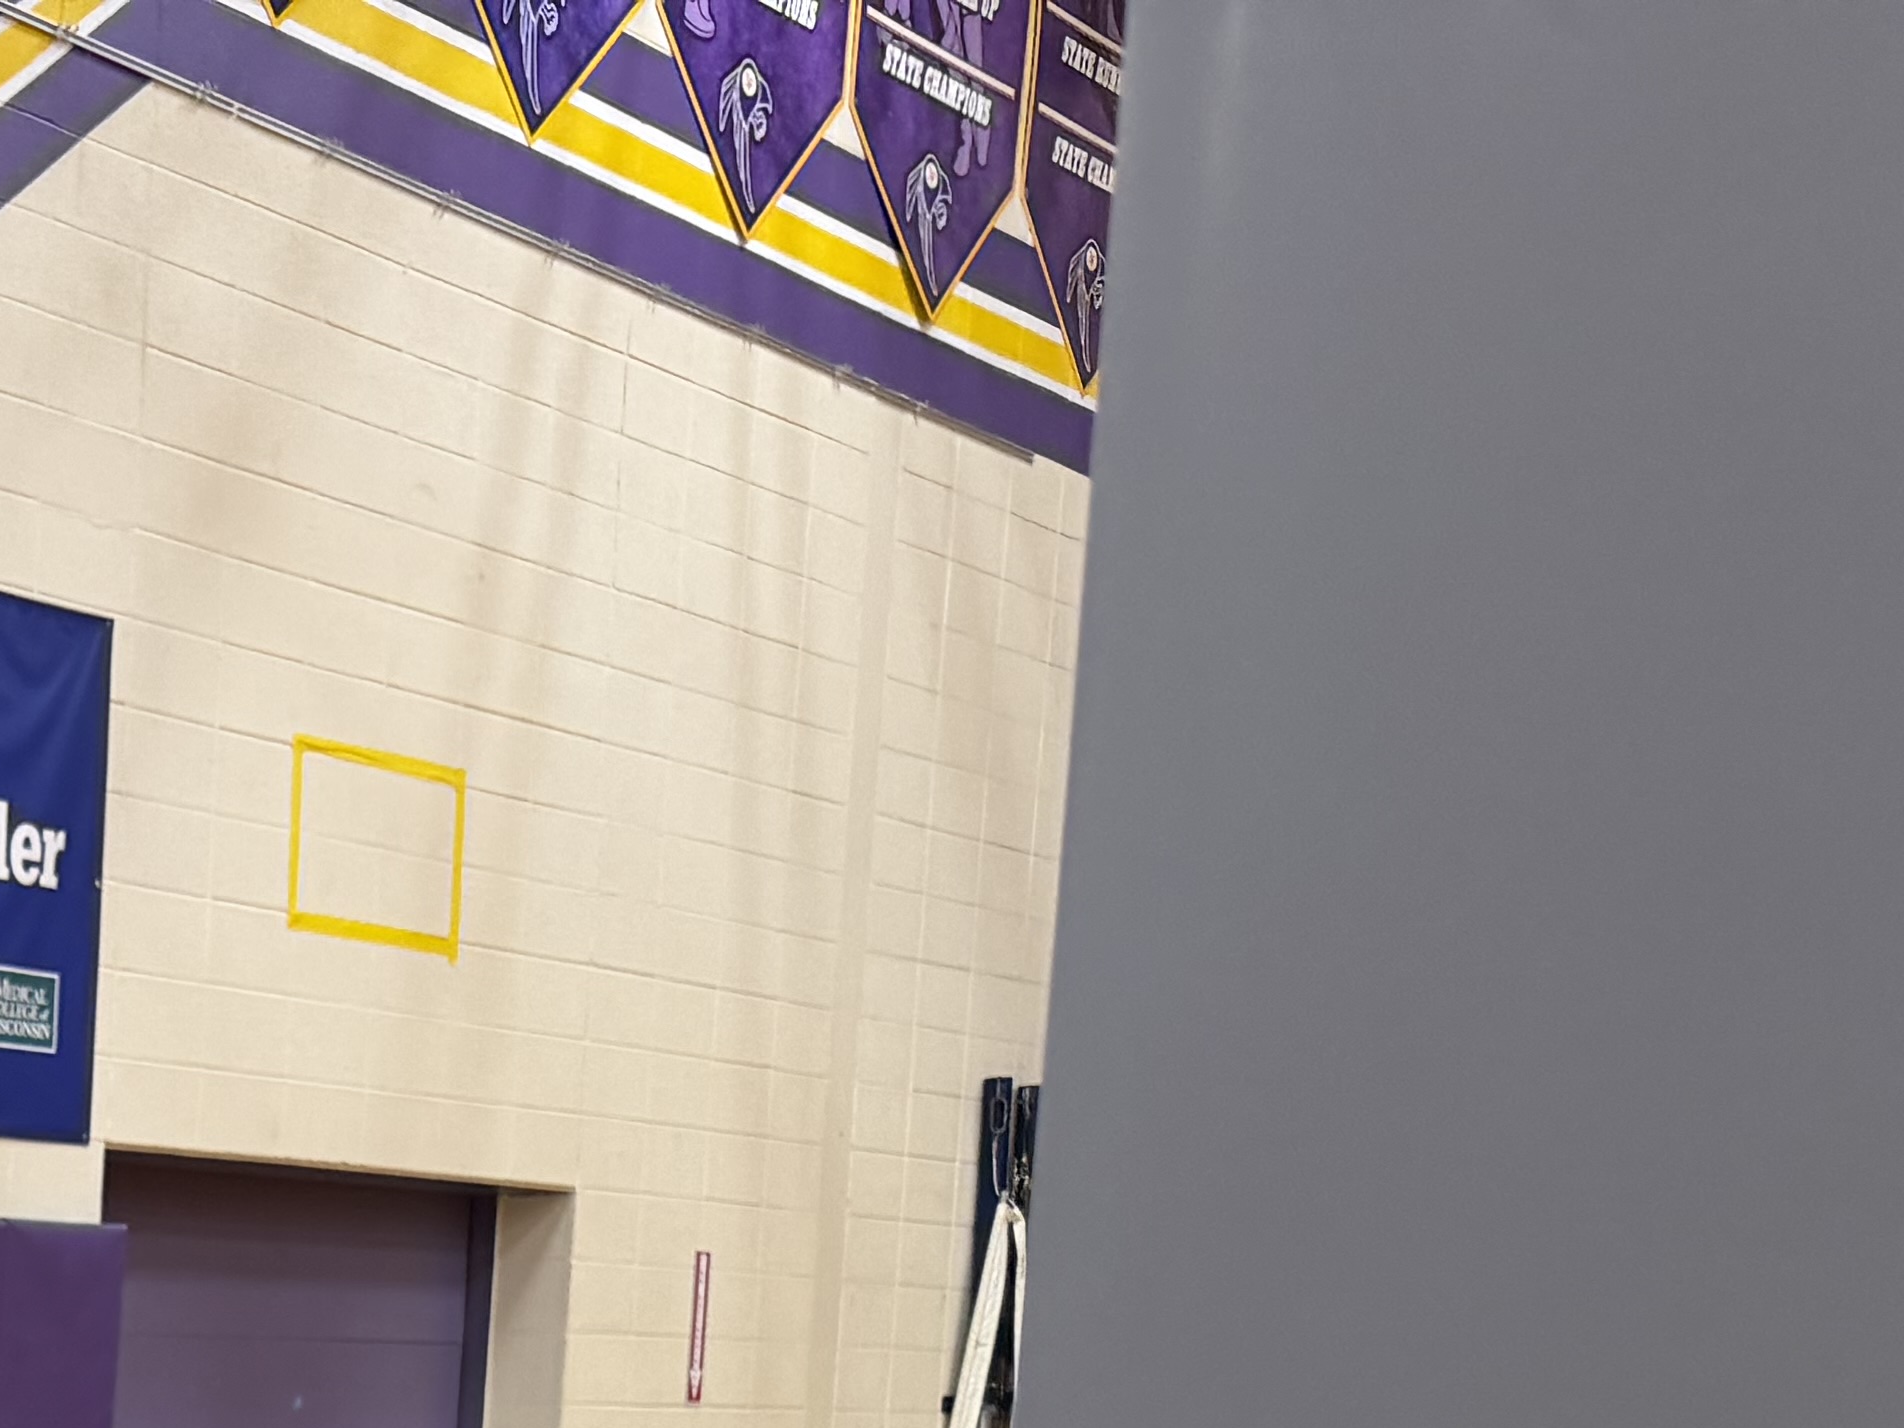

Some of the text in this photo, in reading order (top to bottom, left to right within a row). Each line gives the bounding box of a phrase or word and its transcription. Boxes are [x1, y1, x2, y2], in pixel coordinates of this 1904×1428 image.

[1061, 36, 1097, 80] STATE
[882, 43, 993, 126] STATE CHAMPIONS
[1052, 136, 1088, 178] STATE
